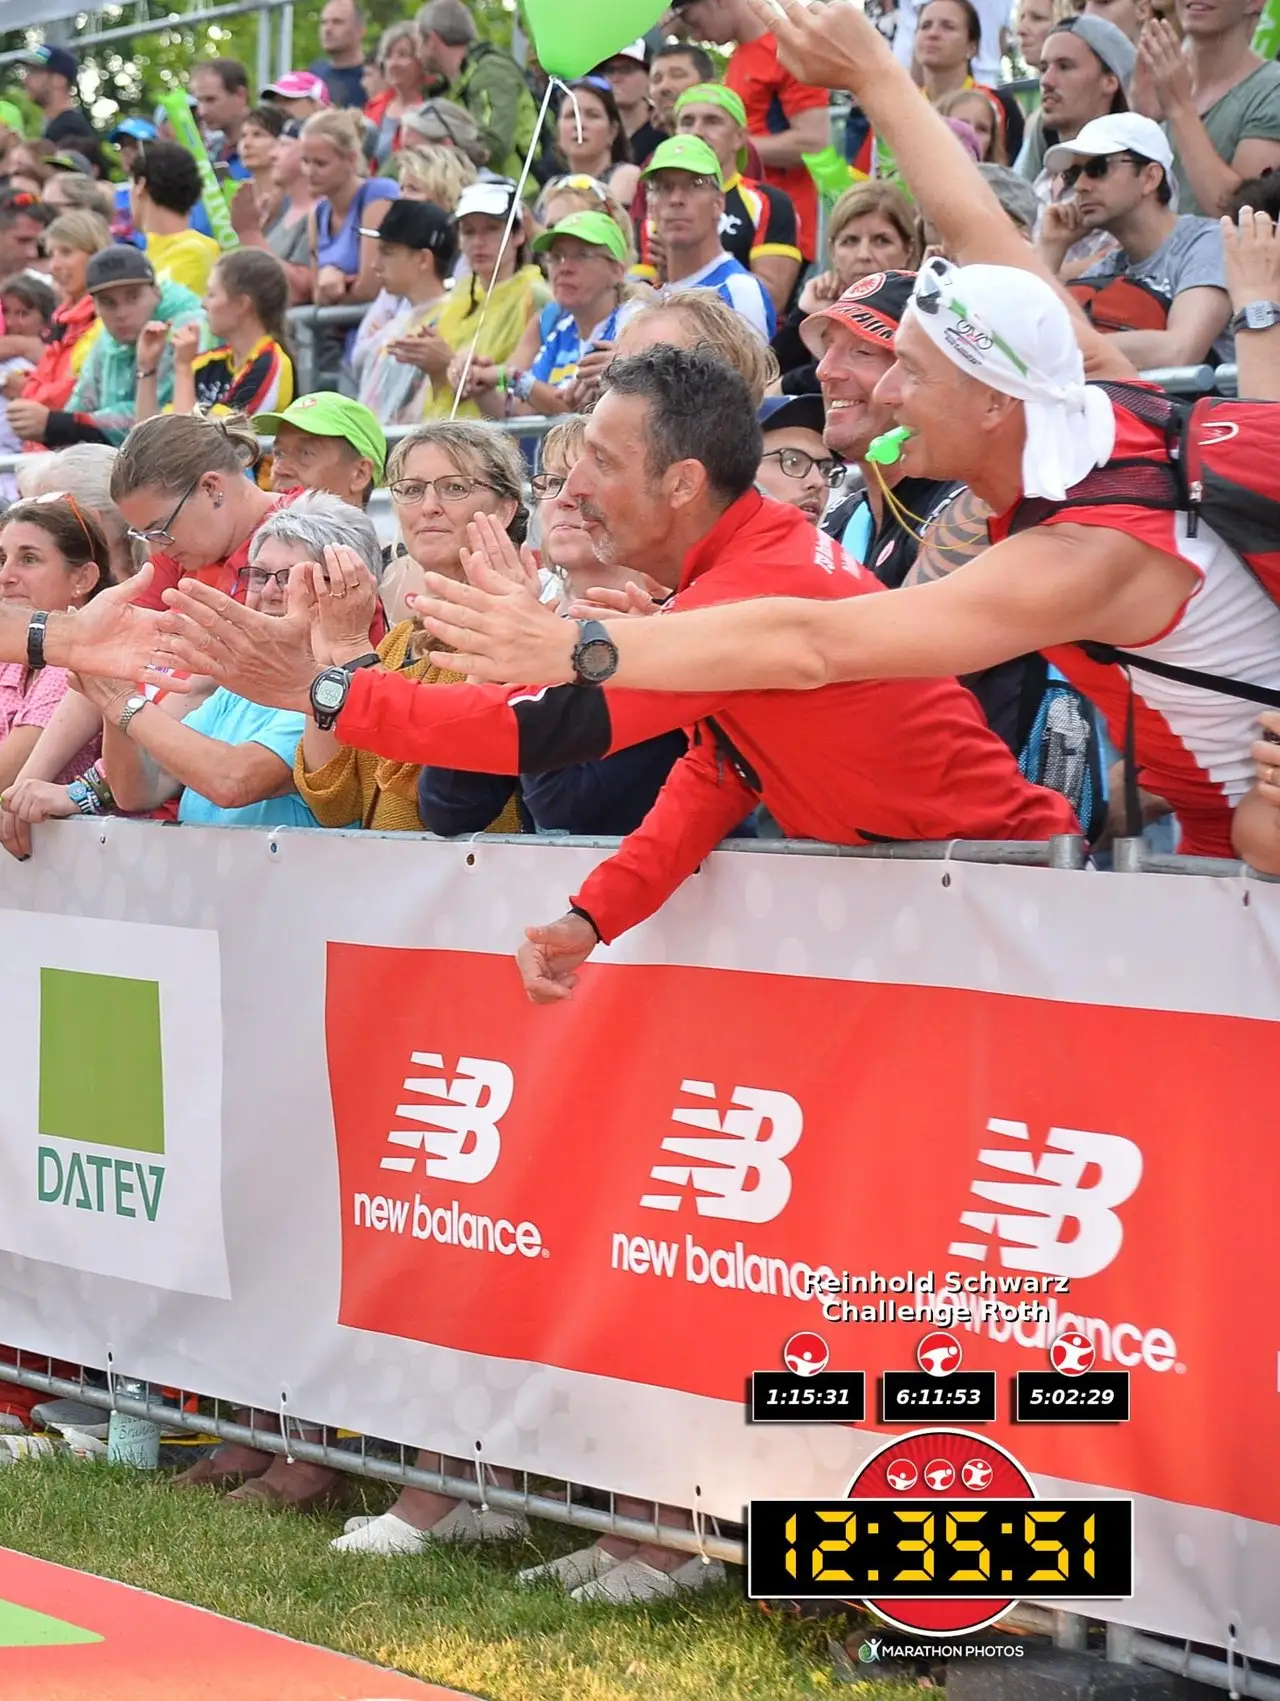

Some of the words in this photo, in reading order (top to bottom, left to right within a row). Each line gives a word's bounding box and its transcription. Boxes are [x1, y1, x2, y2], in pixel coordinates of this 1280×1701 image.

[38, 1146, 166, 1222] DATEV
[354, 1193, 410, 1235] new
[611, 1233, 680, 1279] new
